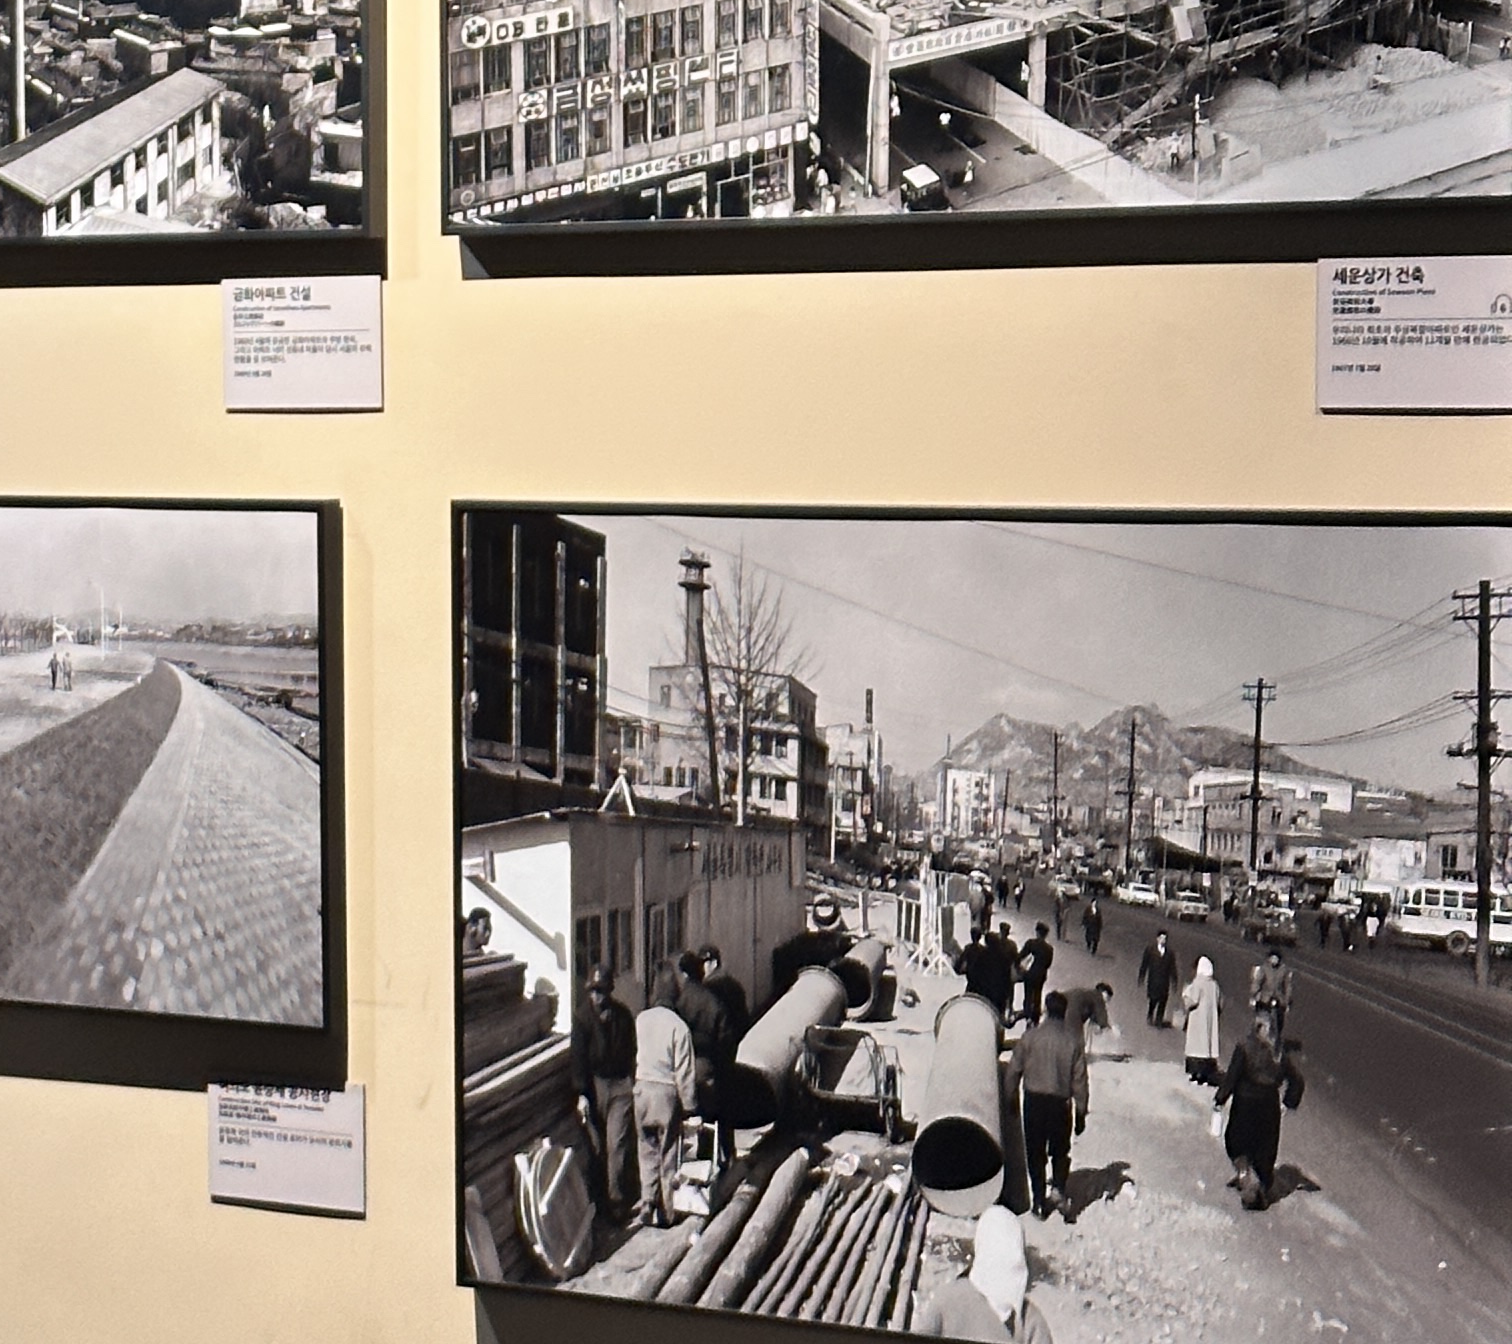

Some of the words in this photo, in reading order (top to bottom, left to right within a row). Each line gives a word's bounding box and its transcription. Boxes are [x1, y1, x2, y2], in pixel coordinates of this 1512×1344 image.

[1332, 267, 1391, 285] 세운상가
[1395, 266, 1425, 284] 건축
[289, 285, 312, 301] 건설
